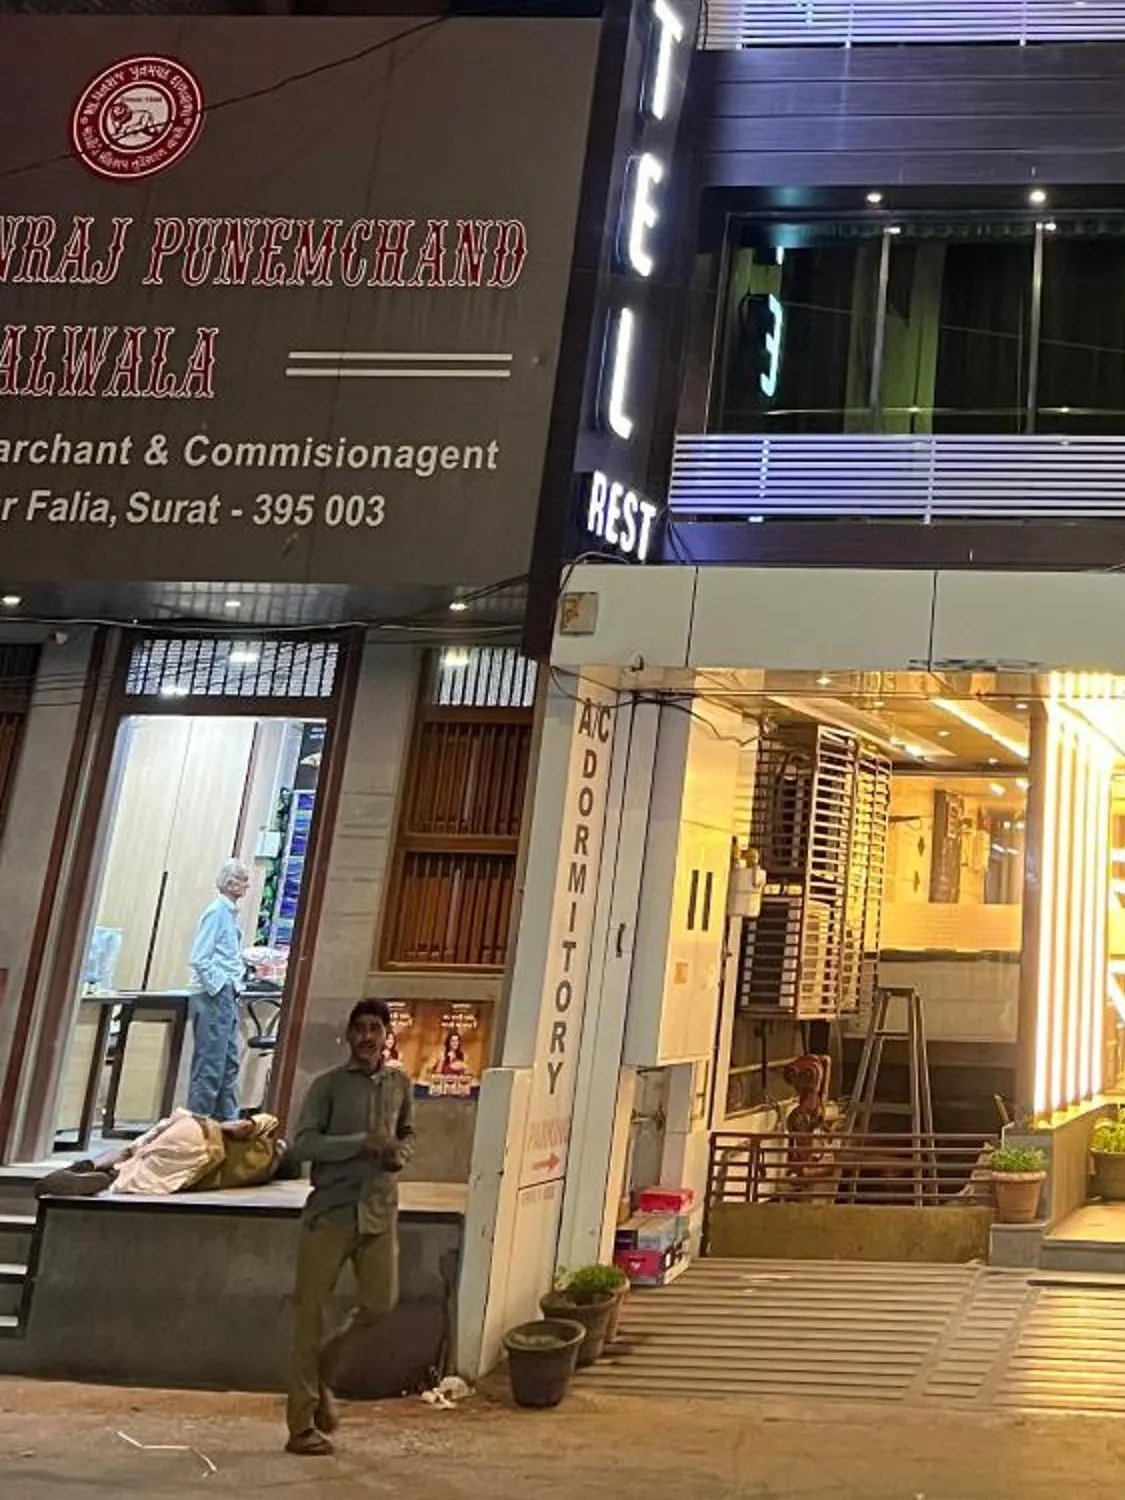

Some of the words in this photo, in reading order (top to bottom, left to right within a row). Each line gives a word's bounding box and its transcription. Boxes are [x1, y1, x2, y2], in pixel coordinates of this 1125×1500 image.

[143, 216, 529, 289] PUNEMCHAND
[0, 324, 220, 399] ALWALA
[0, 433, 133, 466] archant
[143, 433, 169, 466] &
[184, 435, 499, 477] Commisionagent
[26, 489, 117, 529] Falia,
[125, 491, 221, 525] Surat
[252, 492, 316, 526] 395
[324, 494, 386, 527] 003
[587, 468, 657, 561] REST
[546, 748, 599, 1096] DORMITORY
